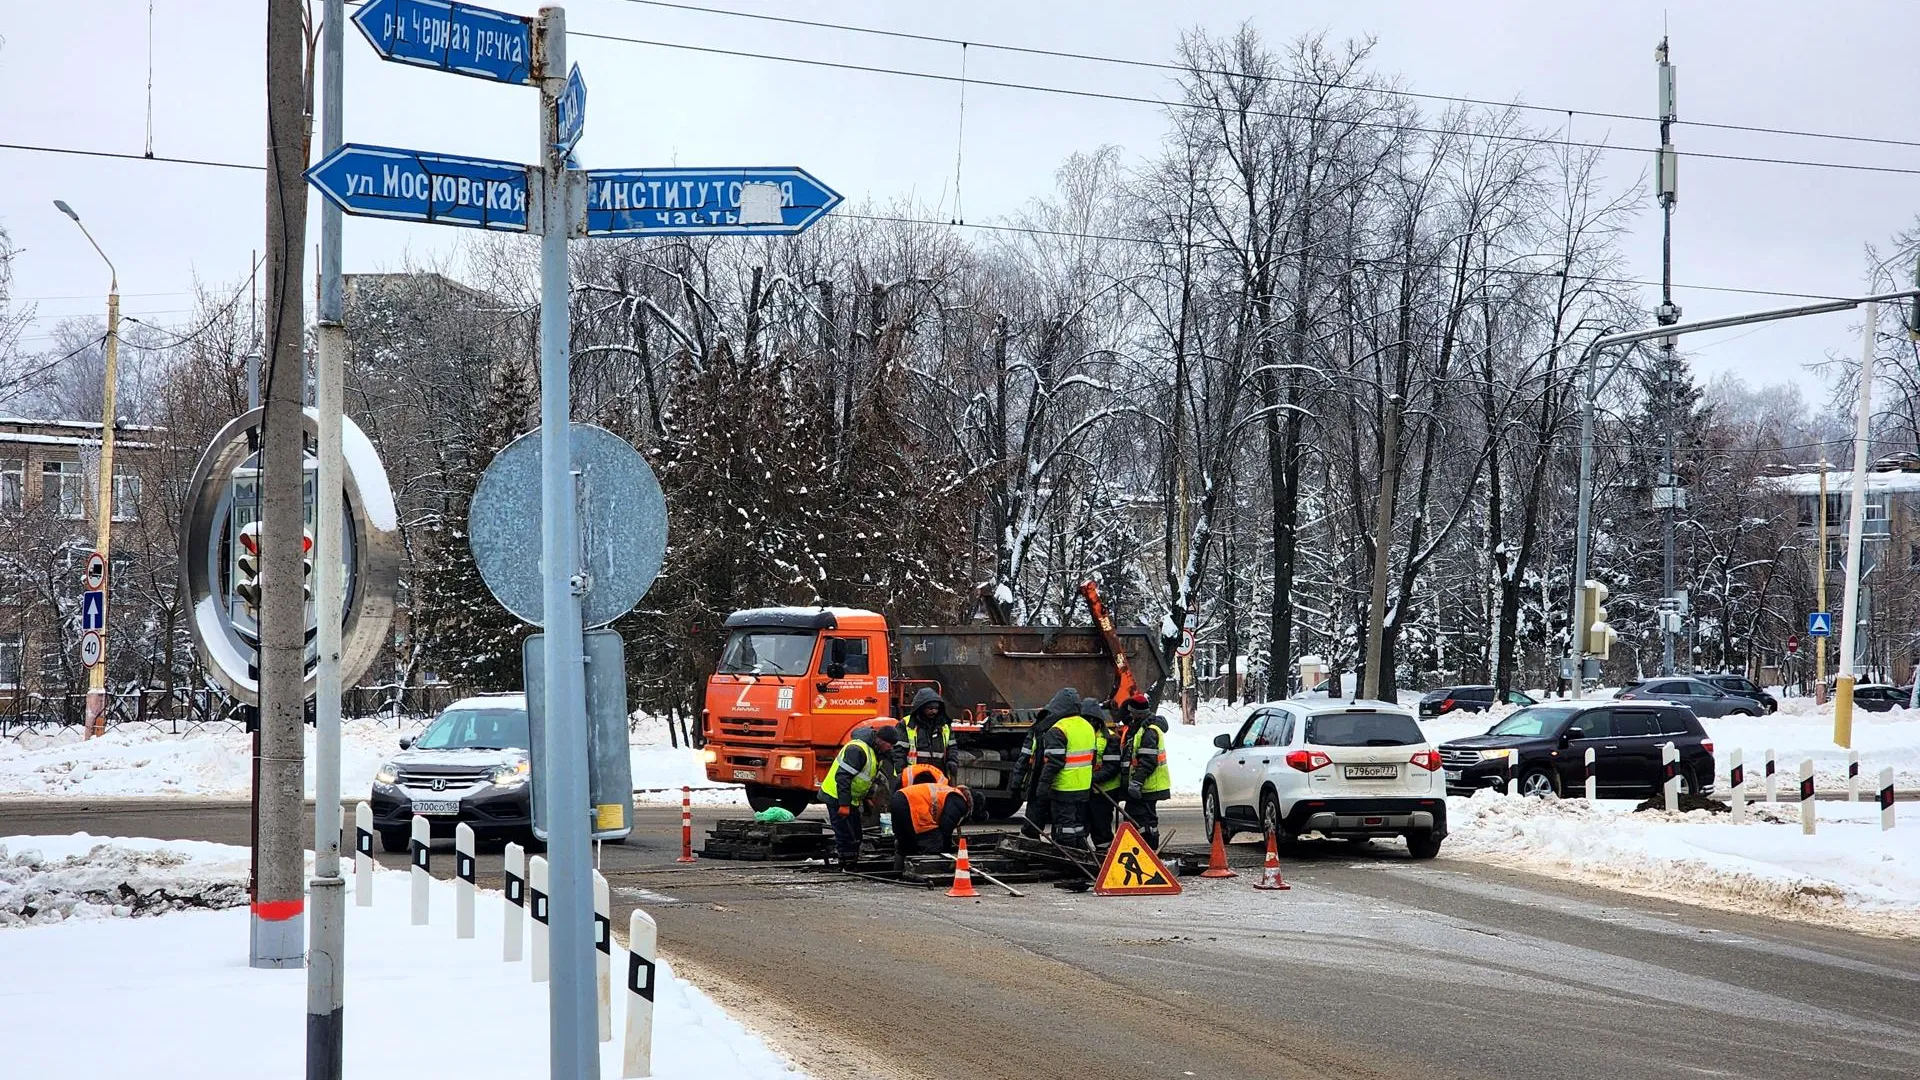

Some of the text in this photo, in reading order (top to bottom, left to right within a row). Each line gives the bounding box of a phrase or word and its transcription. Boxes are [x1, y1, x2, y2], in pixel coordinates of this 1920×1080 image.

[383, 9, 523, 63] р-н Черная речка
[382, 164, 526, 211] Московская
[599, 180, 795, 210] ИНСТИТУТСЯ
[656, 211, 738, 225] часть
[84, 642, 97, 655] 40
